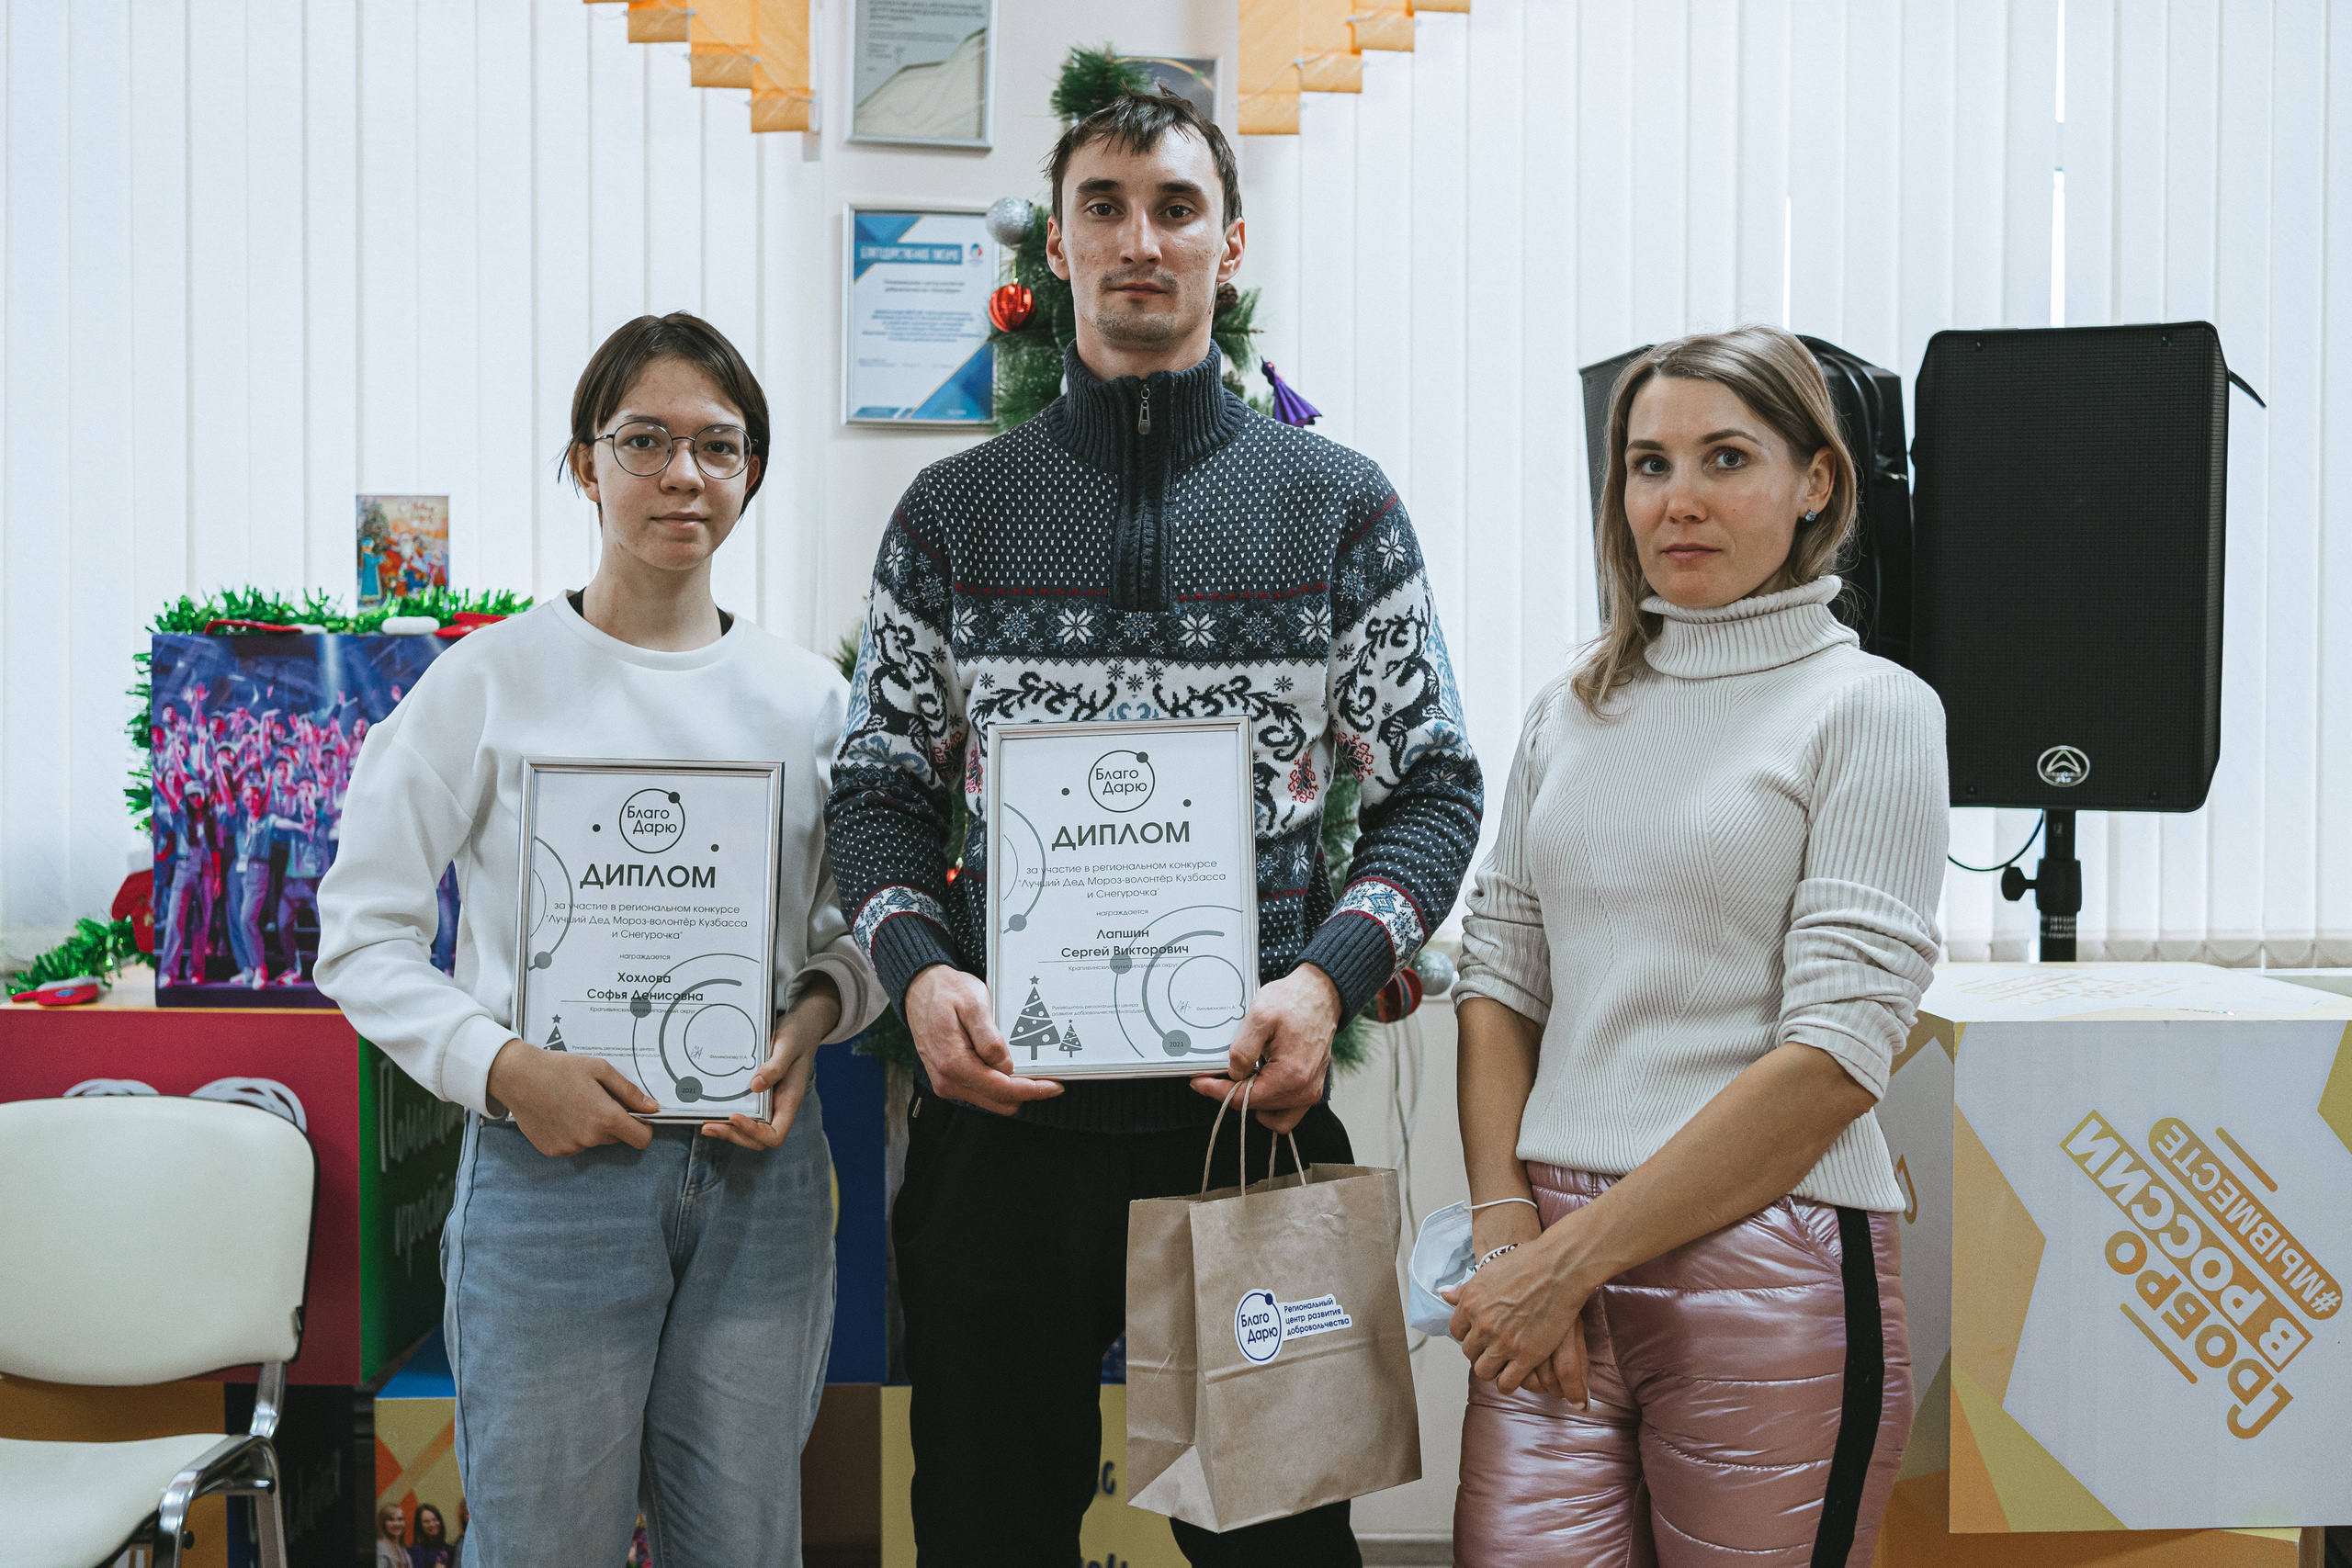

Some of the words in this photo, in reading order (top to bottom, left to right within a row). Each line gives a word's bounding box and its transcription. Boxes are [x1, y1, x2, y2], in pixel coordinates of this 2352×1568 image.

[1095, 768, 1139, 781] Благо
[1102, 781, 1148, 795] Дарю
[627, 806, 670, 819] Благо
[632, 819, 678, 836] Дарю
[1051, 820, 1190, 852] ДИПЛОМ
[1040, 865, 1081, 875] участие
[1092, 863, 1167, 874] региональном
[1169, 860, 1217, 871] конкурсе
[579, 863, 717, 890] ДИПЛОМ
[1062, 877, 1085, 887] Дед
[1087, 874, 1173, 886] Мороз-волонтёр
[1175, 872, 1227, 883] Кузбасса
[568, 903, 608, 912] участие
[618, 904, 691, 913] региональном
[693, 906, 741, 915] конкурсе
[1095, 908, 1149, 917] награждается
[589, 916, 611, 925] Дед
[613, 916, 696, 928] Мороз-волонтёр
[698, 918, 748, 929] Кузбасса
[1096, 929, 1149, 940] Лапшин
[619, 953, 671, 961] награждается
[1061, 945, 1110, 960] Сергей
[1114, 944, 1189, 957] Викторович
[616, 972, 672, 984] Хохлова
[586, 987, 628, 1001] Софья
[630, 989, 704, 1001] Денисовна
[2066, 1117, 2267, 1327] РОССИИ
[2156, 1123, 2340, 1314] #МЫВМЕСТЕ
[1283, 1298, 1334, 1314] Региональный
[1240, 1312, 1270, 1328] Благо
[1285, 1314, 1306, 1325] центр
[1307, 1308, 1341, 1322] развития
[1247, 1325, 1278, 1344] Дарю
[1286, 1317, 1351, 1337] добровольчества
